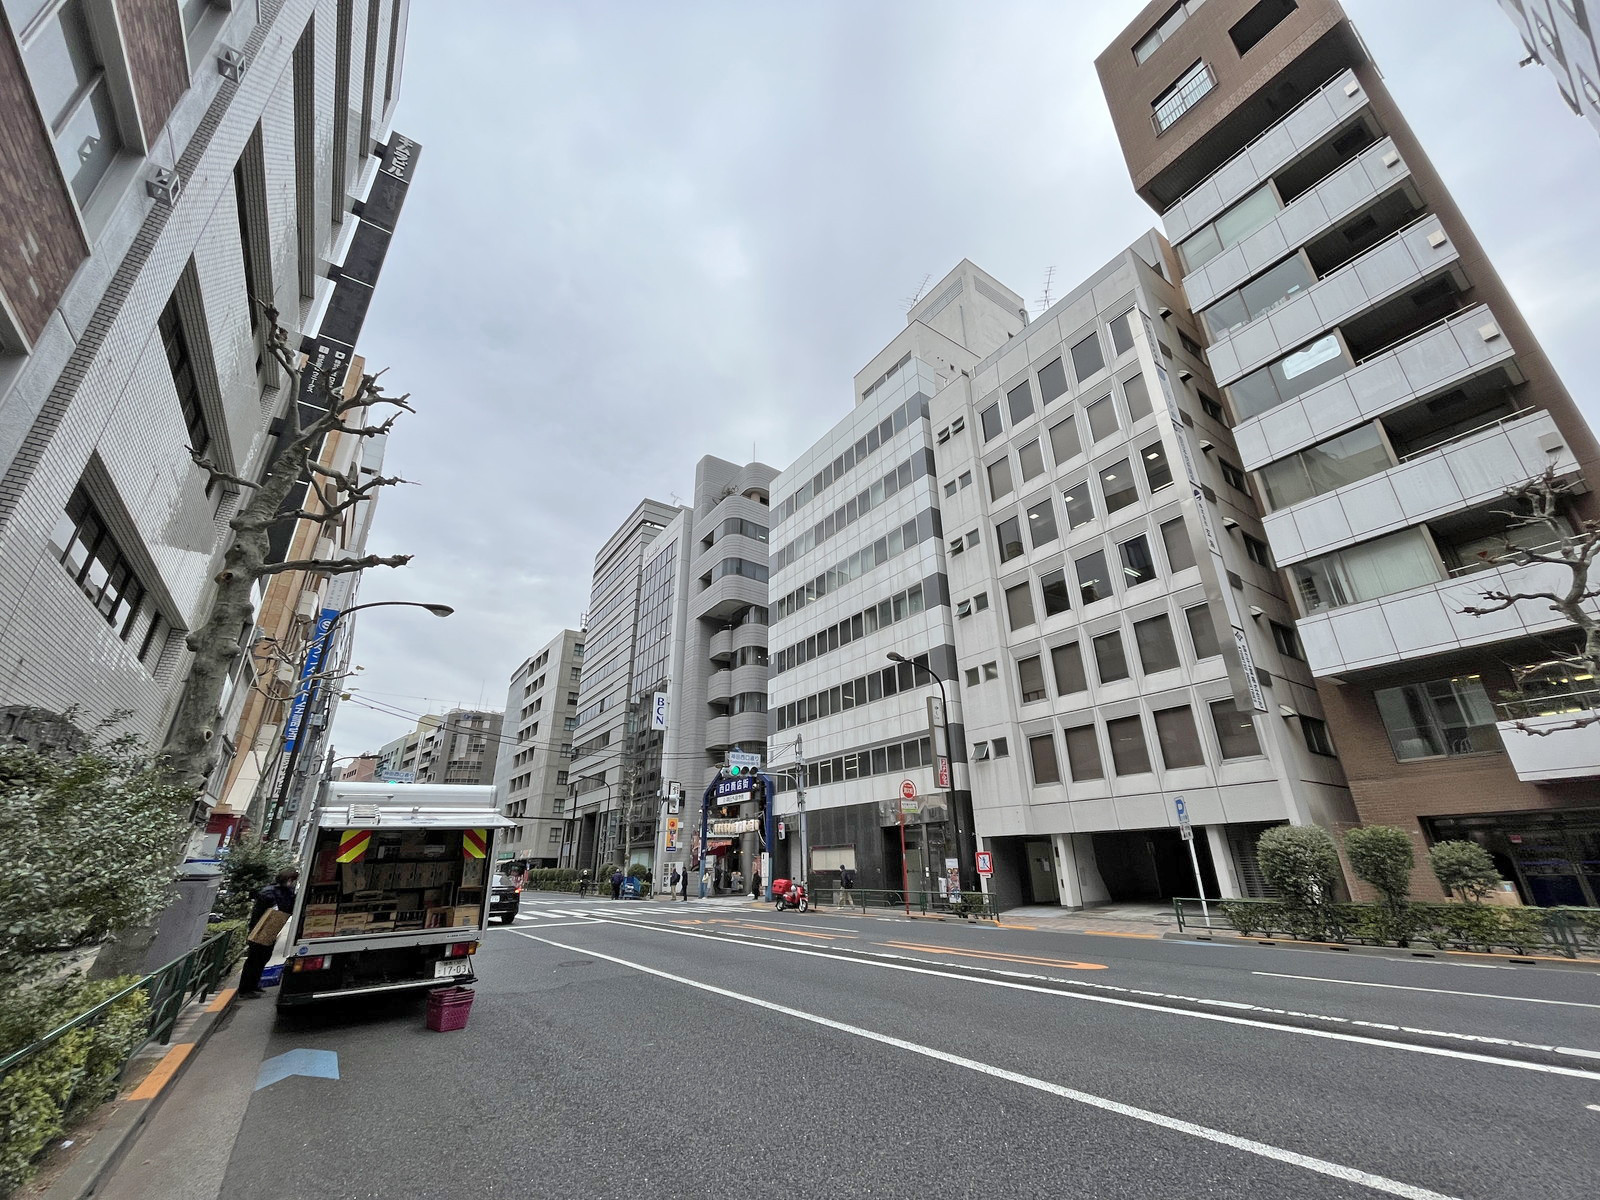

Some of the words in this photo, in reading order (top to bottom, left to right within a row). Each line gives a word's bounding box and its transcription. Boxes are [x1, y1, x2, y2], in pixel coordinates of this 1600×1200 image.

[656, 697, 665, 725] BCN
[719, 778, 749, 794] 西口商店街
